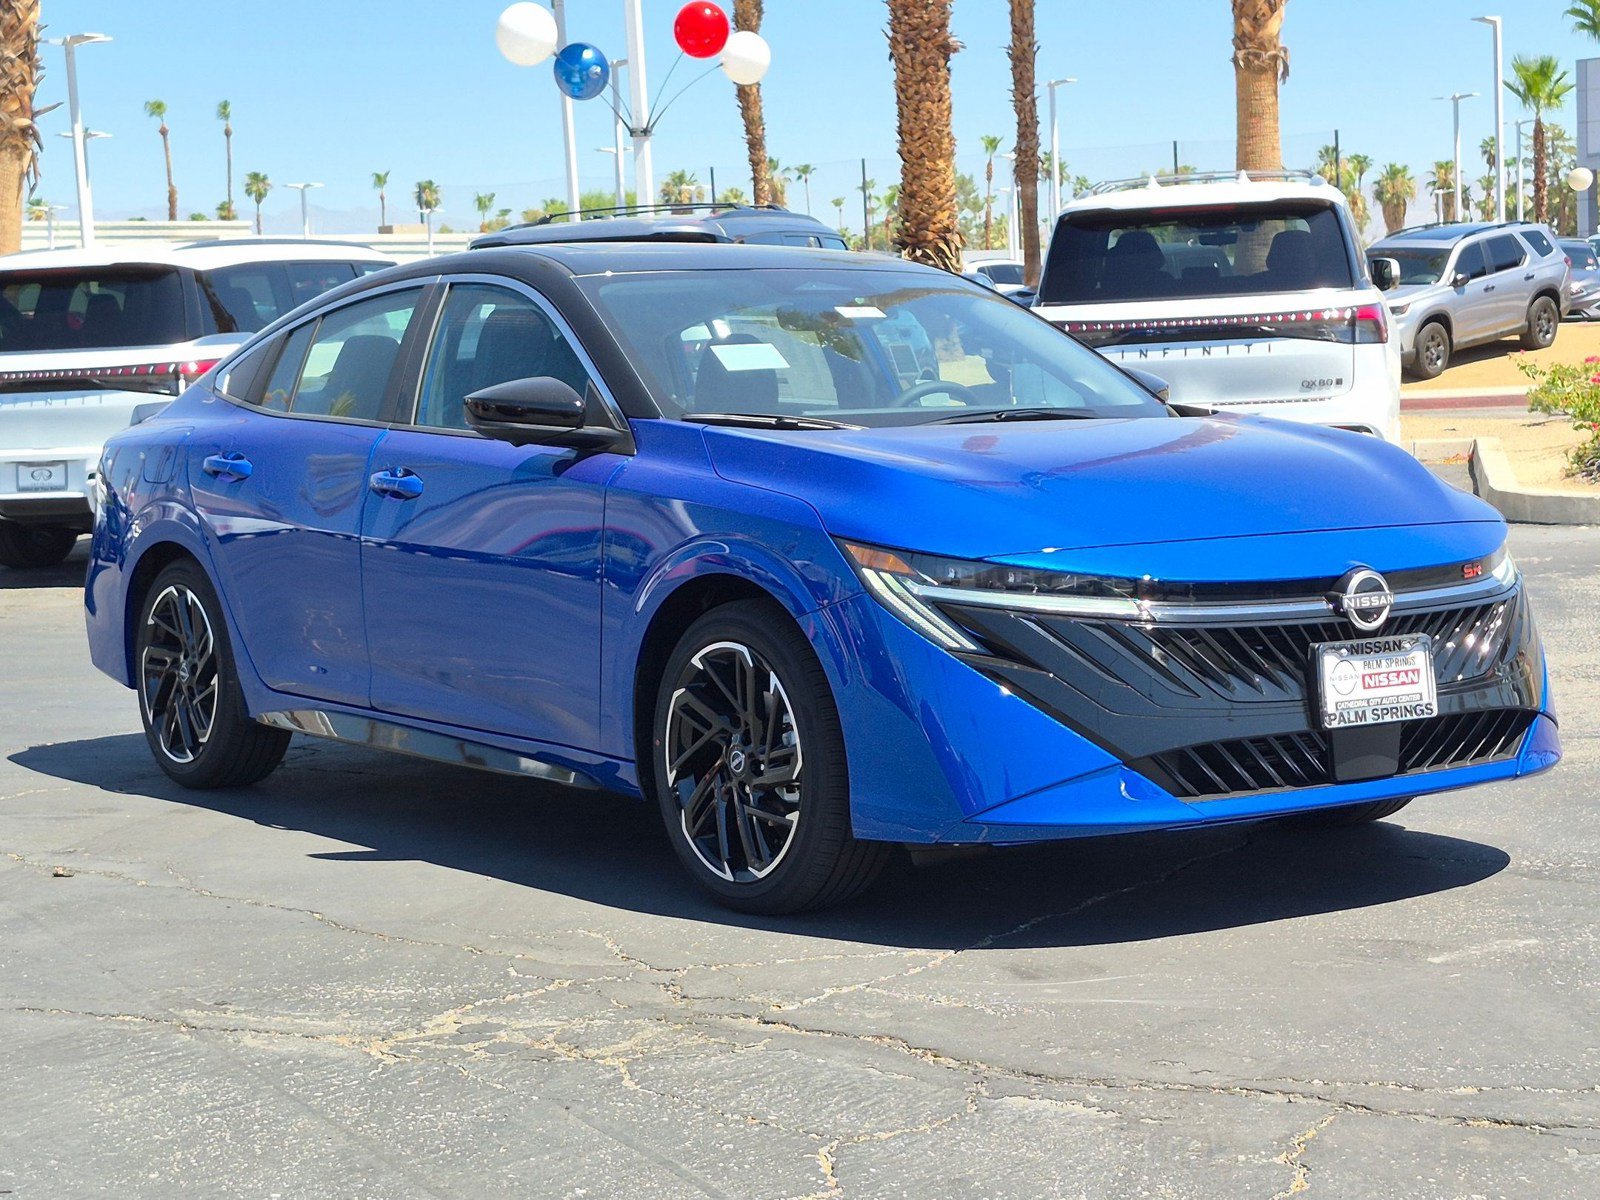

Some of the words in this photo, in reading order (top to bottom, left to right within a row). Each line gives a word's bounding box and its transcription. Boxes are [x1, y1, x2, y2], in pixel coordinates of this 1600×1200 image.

[1121, 343, 1271, 360] INFINITI
[1301, 378, 1334, 389] QX80
[1463, 563, 1482, 578] SR
[1344, 594, 1394, 608] NISSAN
[1350, 640, 1401, 656] NISSAN
[1363, 659, 1383, 670] PALM
[1385, 656, 1416, 669] SPRINGS
[1329, 673, 1360, 682] NISSAN
[1363, 670, 1419, 688] NISSAN
[1337, 699, 1369, 709] CATHEDRAL
[1369, 698, 1381, 706] CITY
[1382, 696, 1398, 705] AUTO
[1398, 693, 1421, 703] CENTER
[1327, 709, 1367, 726] PALM
[1371, 703, 1434, 721] SPRINGS
